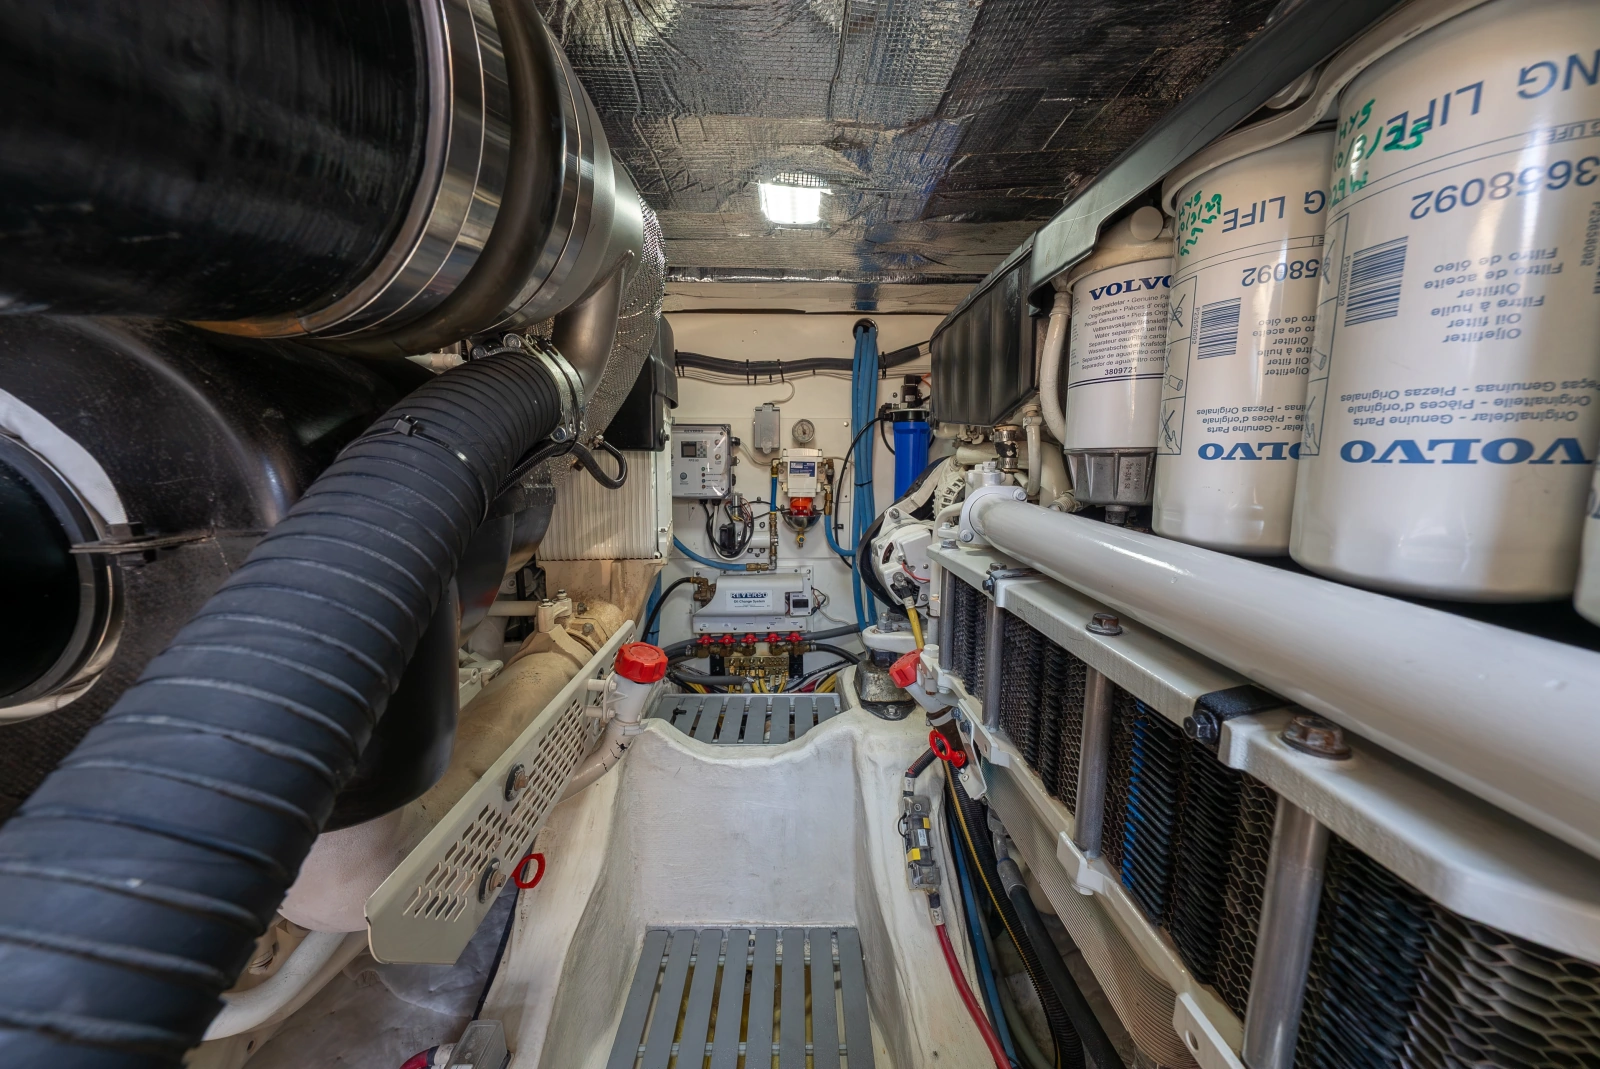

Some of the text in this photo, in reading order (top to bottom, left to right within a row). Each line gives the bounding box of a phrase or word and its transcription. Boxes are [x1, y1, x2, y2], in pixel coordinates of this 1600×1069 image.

[1386, 80, 1484, 143] LIFE
[1410, 155, 1600, 220] 3658092
[1221, 195, 1286, 234] LIFE
[1433, 247, 1559, 274] Filtro de óleo
[1241, 258, 1320, 287] 58092
[1423, 262, 1564, 290] Filtro de aceite
[1497, 295, 1546, 308] Filtre
[1430, 303, 1473, 317] huile
[1446, 313, 1522, 329] Oil filter
[1252, 328, 1285, 337] aceite
[1288, 326, 1302, 334] de
[1442, 327, 1522, 343] Oljefilter
[1267, 357, 1310, 366] Oil filter
[1104, 366, 1137, 376] 3809721
[1264, 367, 1310, 376] Oljefilter
[1404, 385, 1456, 398] Piezas
[1475, 381, 1557, 393] Genuinas
[1340, 389, 1400, 402] Originales
[1493, 394, 1592, 408] Originalteile
[1196, 406, 1239, 416] Originales
[1242, 405, 1274, 413] Piezas
[1419, 398, 1474, 411] Pièces
[1252, 415, 1285, 424] Pièces
[1352, 416, 1385, 427] Parts
[1389, 413, 1453, 425] Genuine
[1470, 410, 1579, 423] Originaldelar
[1207, 426, 1230, 434] Parts
[1232, 425, 1272, 433] Genuine
[1197, 442, 1301, 461] LVO
[1340, 437, 1596, 465] VOLVO
